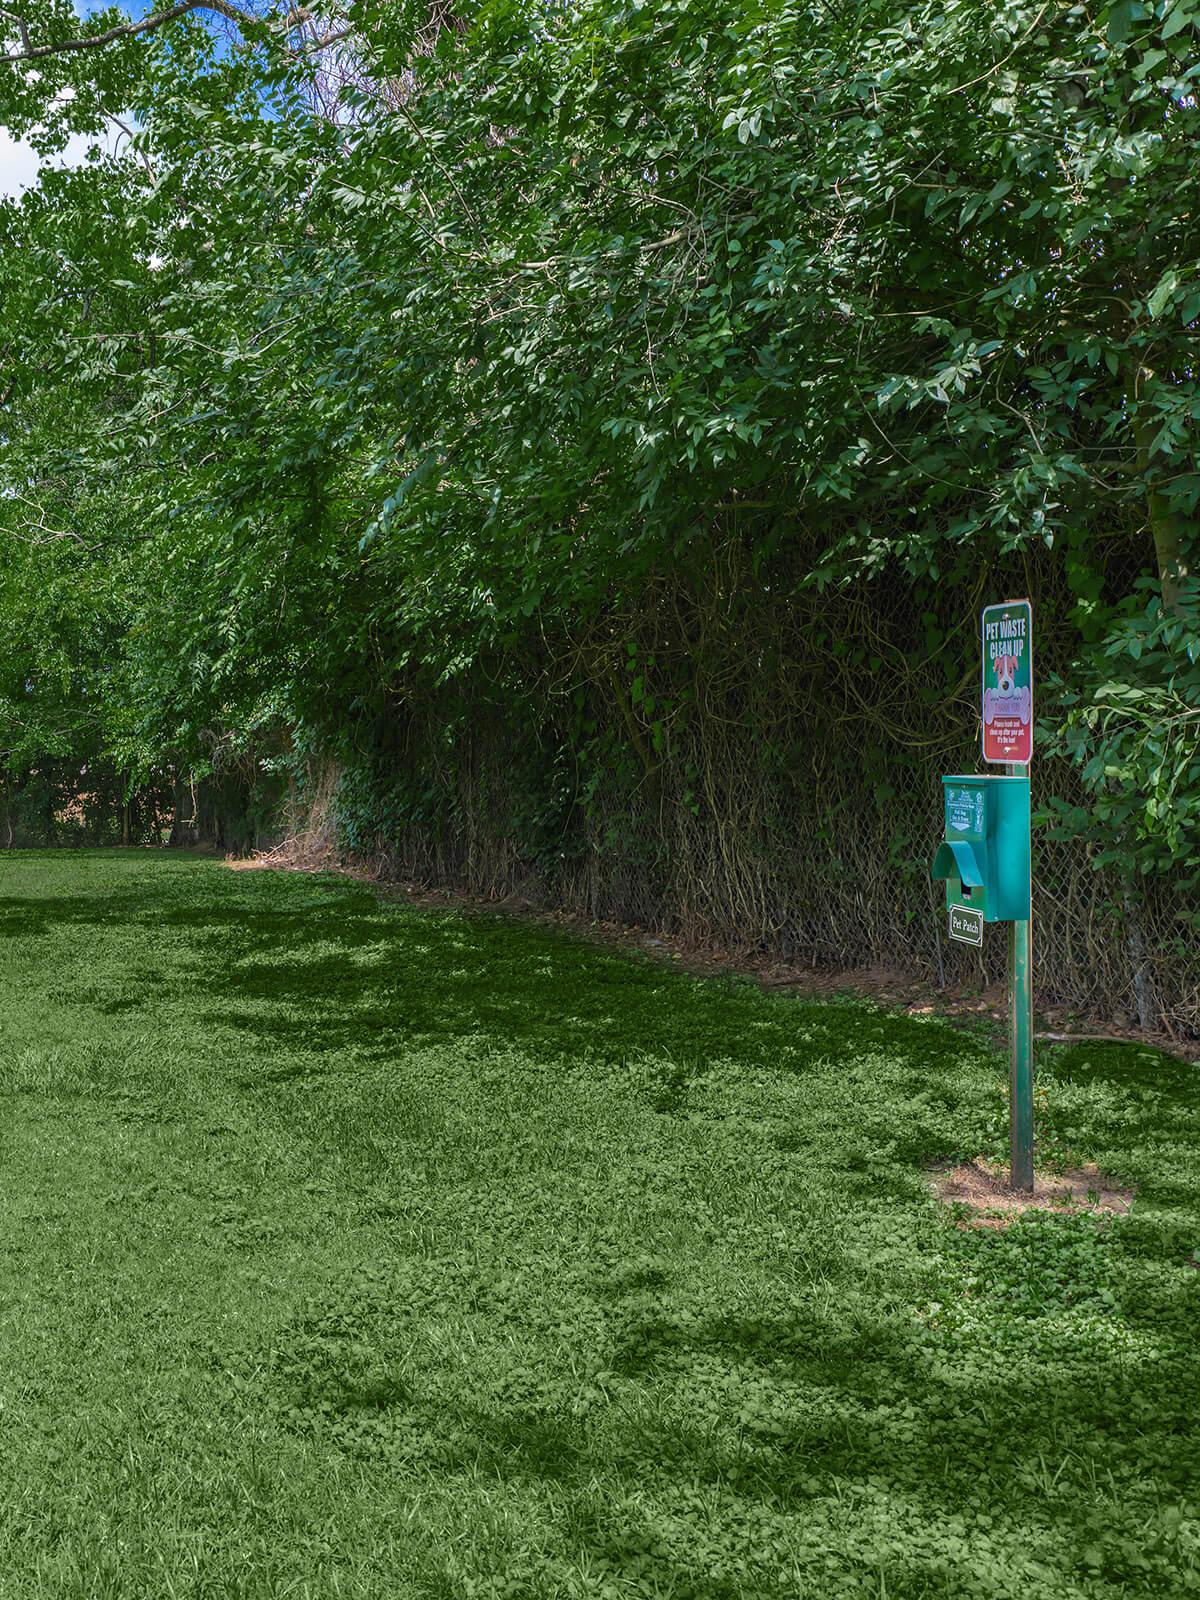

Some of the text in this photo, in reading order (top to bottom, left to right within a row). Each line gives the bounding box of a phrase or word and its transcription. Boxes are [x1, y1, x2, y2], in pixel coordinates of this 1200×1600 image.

[986, 618, 1025, 640] PET WASTE
[991, 639, 1023, 659] CLEAN UP
[953, 916, 978, 934] Pet Patch
